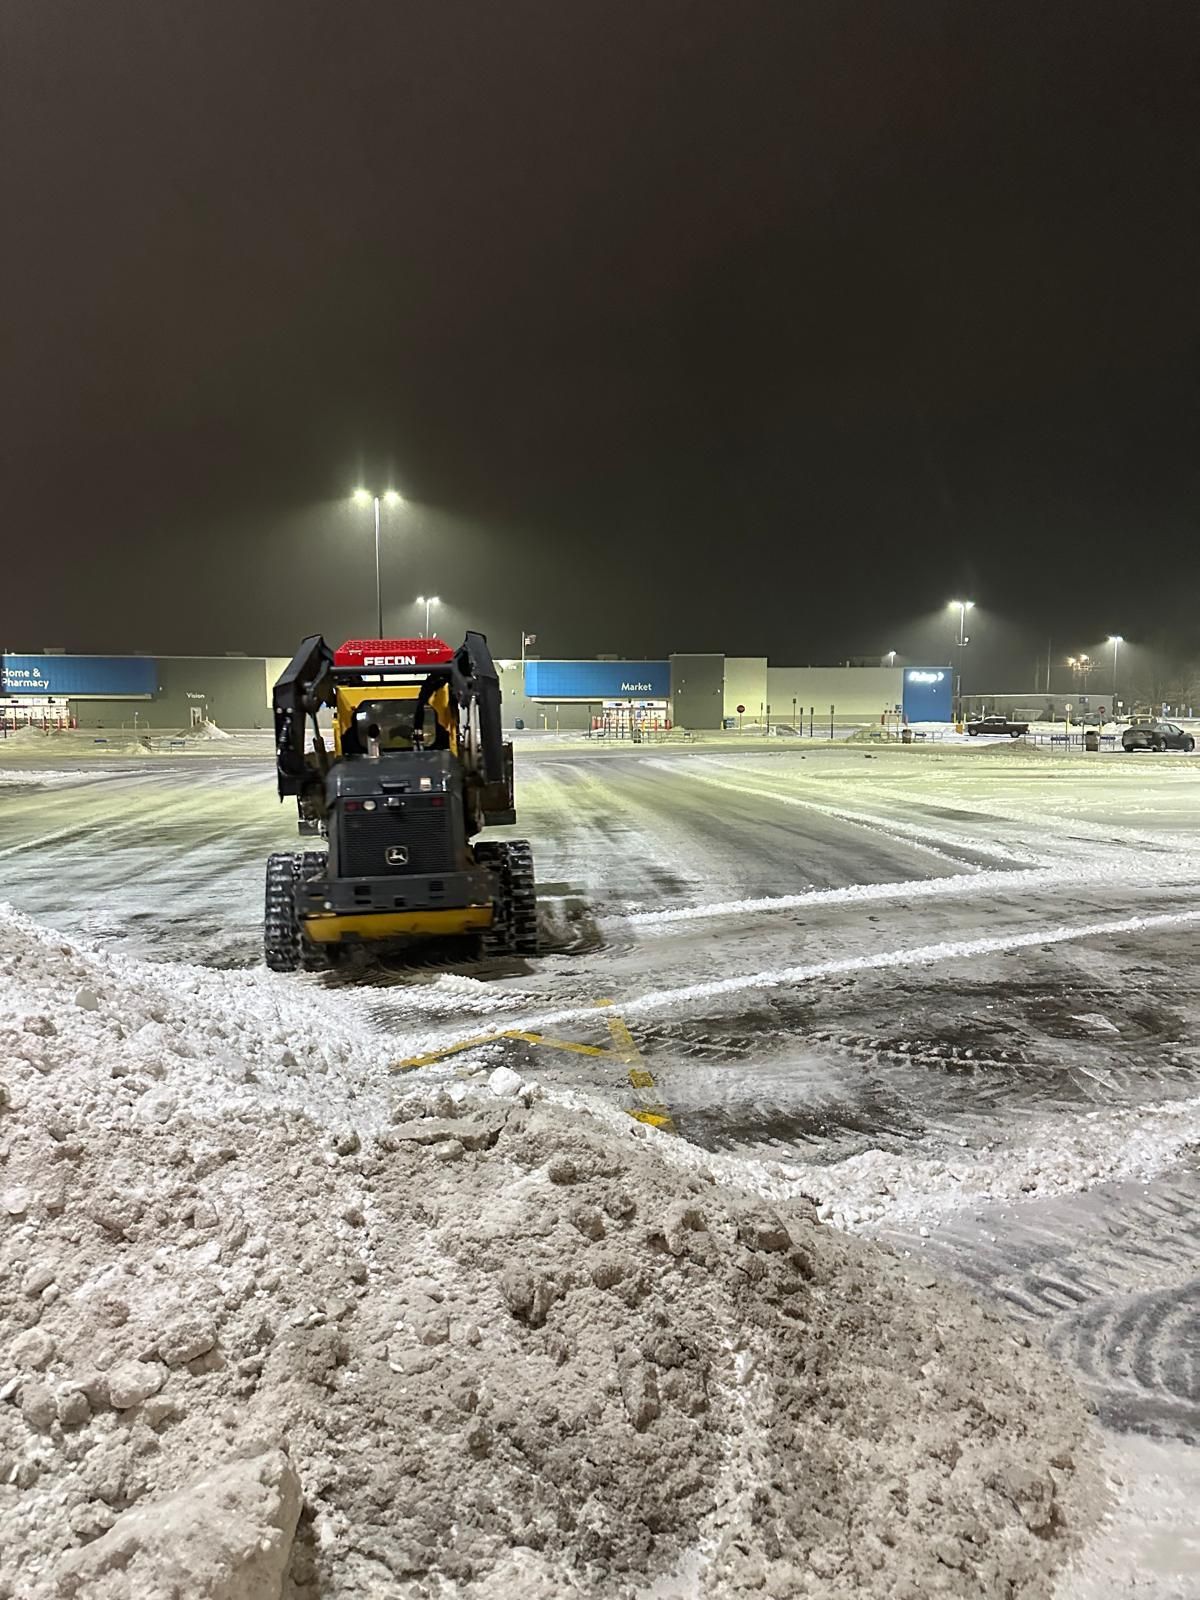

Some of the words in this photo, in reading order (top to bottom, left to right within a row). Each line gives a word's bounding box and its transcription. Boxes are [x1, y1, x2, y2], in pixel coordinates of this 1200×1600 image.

[363, 655, 416, 667] FECON
[32, 667, 41, 677] &
[621, 682, 652, 691] Market
